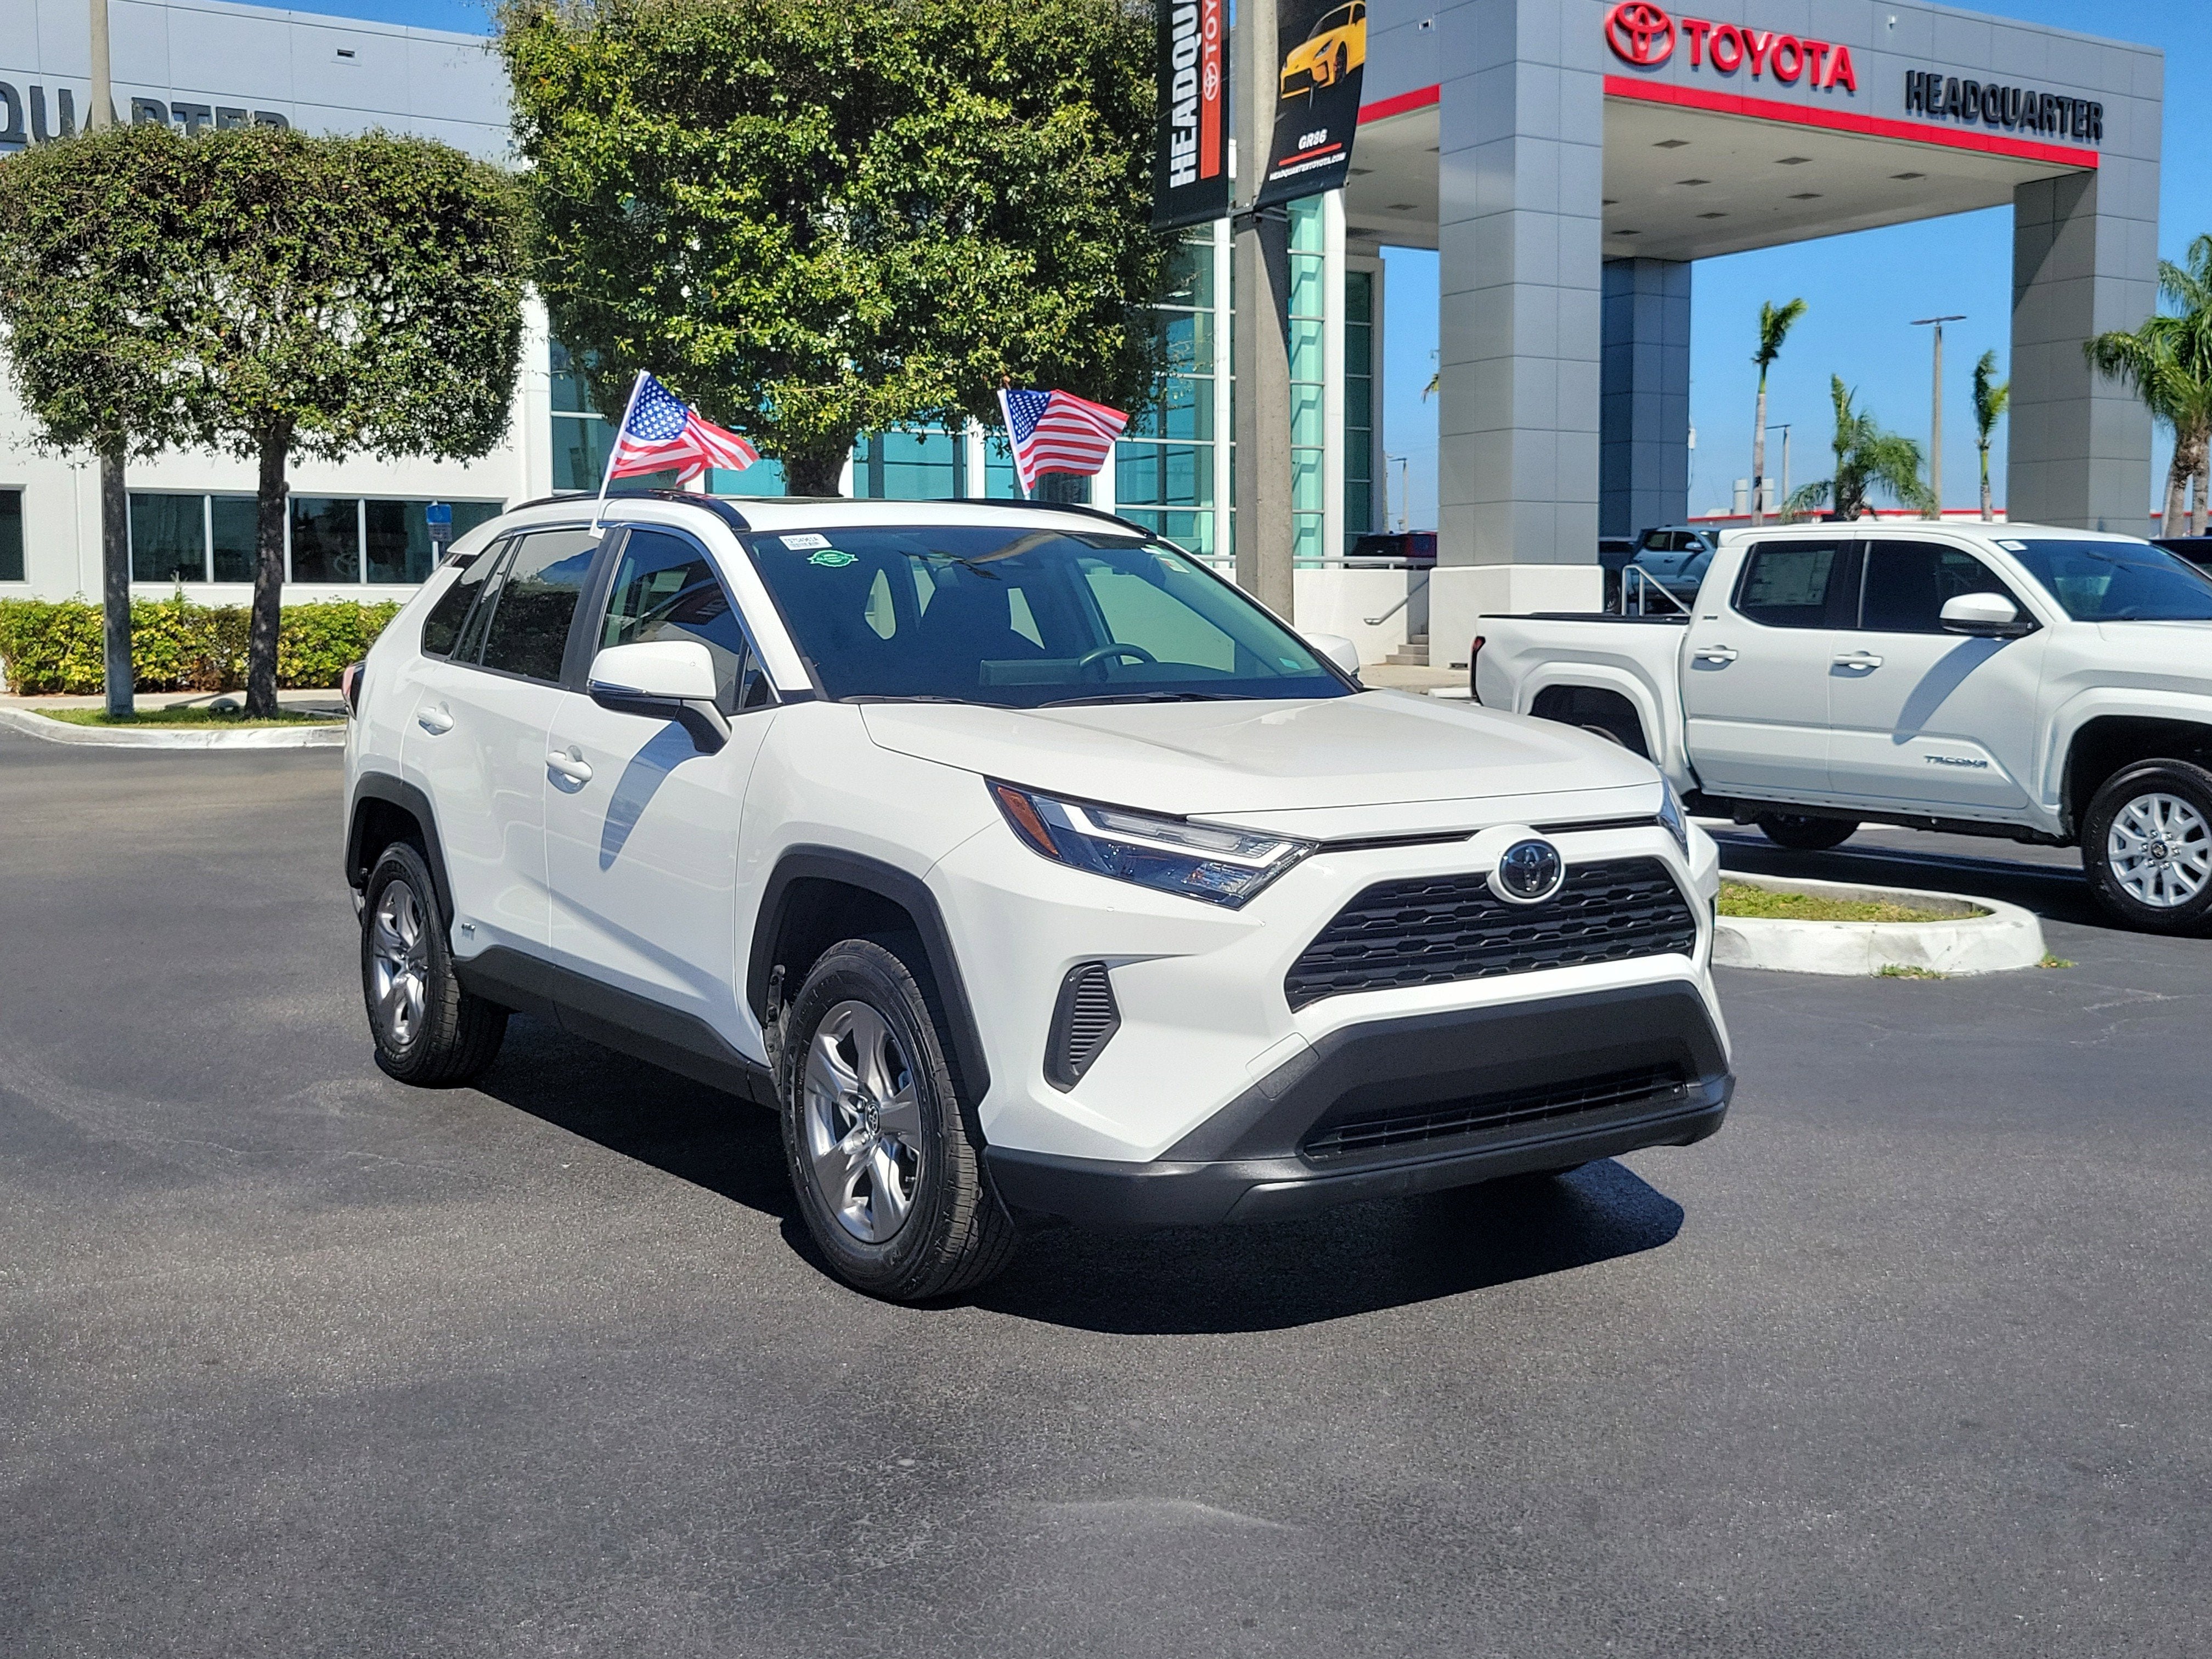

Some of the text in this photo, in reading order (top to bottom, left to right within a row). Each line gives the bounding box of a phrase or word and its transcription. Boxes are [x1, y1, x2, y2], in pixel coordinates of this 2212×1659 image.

[1681, 18, 1858, 92] TOYOTA
[1170, 0, 1202, 188] HEADQU
[1905, 70, 2104, 141] HEADQUARTER
[1298, 128, 1328, 150] GR86
